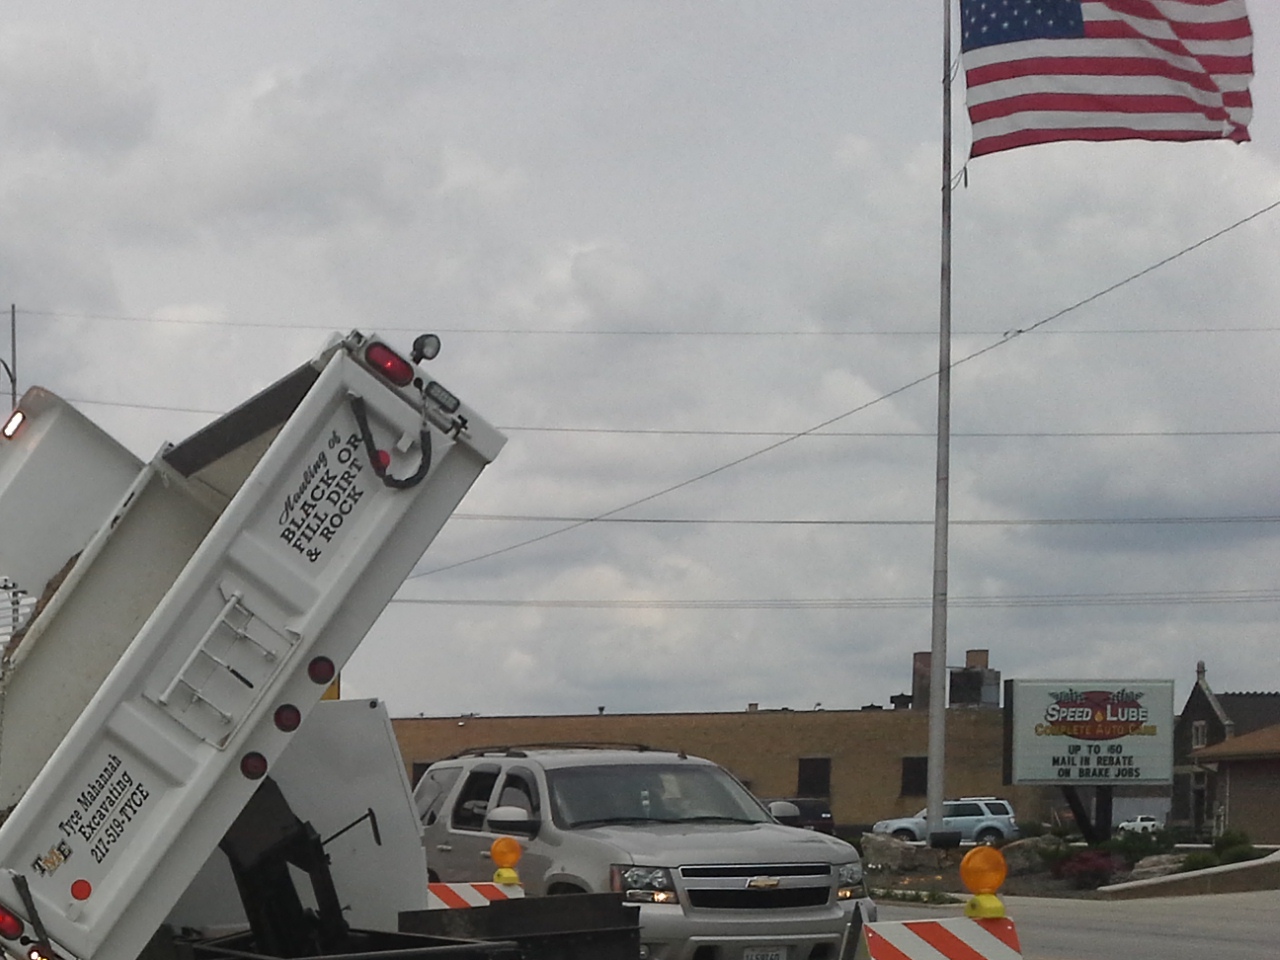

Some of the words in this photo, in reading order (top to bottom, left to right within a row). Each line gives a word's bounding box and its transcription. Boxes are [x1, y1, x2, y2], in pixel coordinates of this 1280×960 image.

[279, 451, 328, 525] Hauling
[328, 430, 341, 449] of
[280, 469, 337, 544] BLACK
[338, 433, 364, 464] OR
[292, 511, 328, 554] FILL
[326, 458, 363, 506] DIRT
[306, 547, 322, 562] &
[319, 485, 364, 543] ROCK
[1046, 704, 1092, 722] SPEED
[1106, 704, 1148, 722] LUBE
[1095, 724, 1124, 735] AUTO
[1052, 756, 1077, 766] MAIL
[1080, 756, 1090, 766] IN
[1097, 756, 1134, 766] REBATE
[1057, 768, 1070, 778] ON
[1079, 768, 1109, 778] BRAKE
[1115, 768, 1141, 778] JOBS
[1068, 745, 1081, 755] UP
[1087, 745, 1101, 755] TO
[58, 810, 82, 837] Tyce
[77, 754, 122, 812] Mahannah
[78, 771, 133, 842] Excavating
[91, 783, 150, 864] 217-519-TYCE
[31, 839, 73, 877] TME
